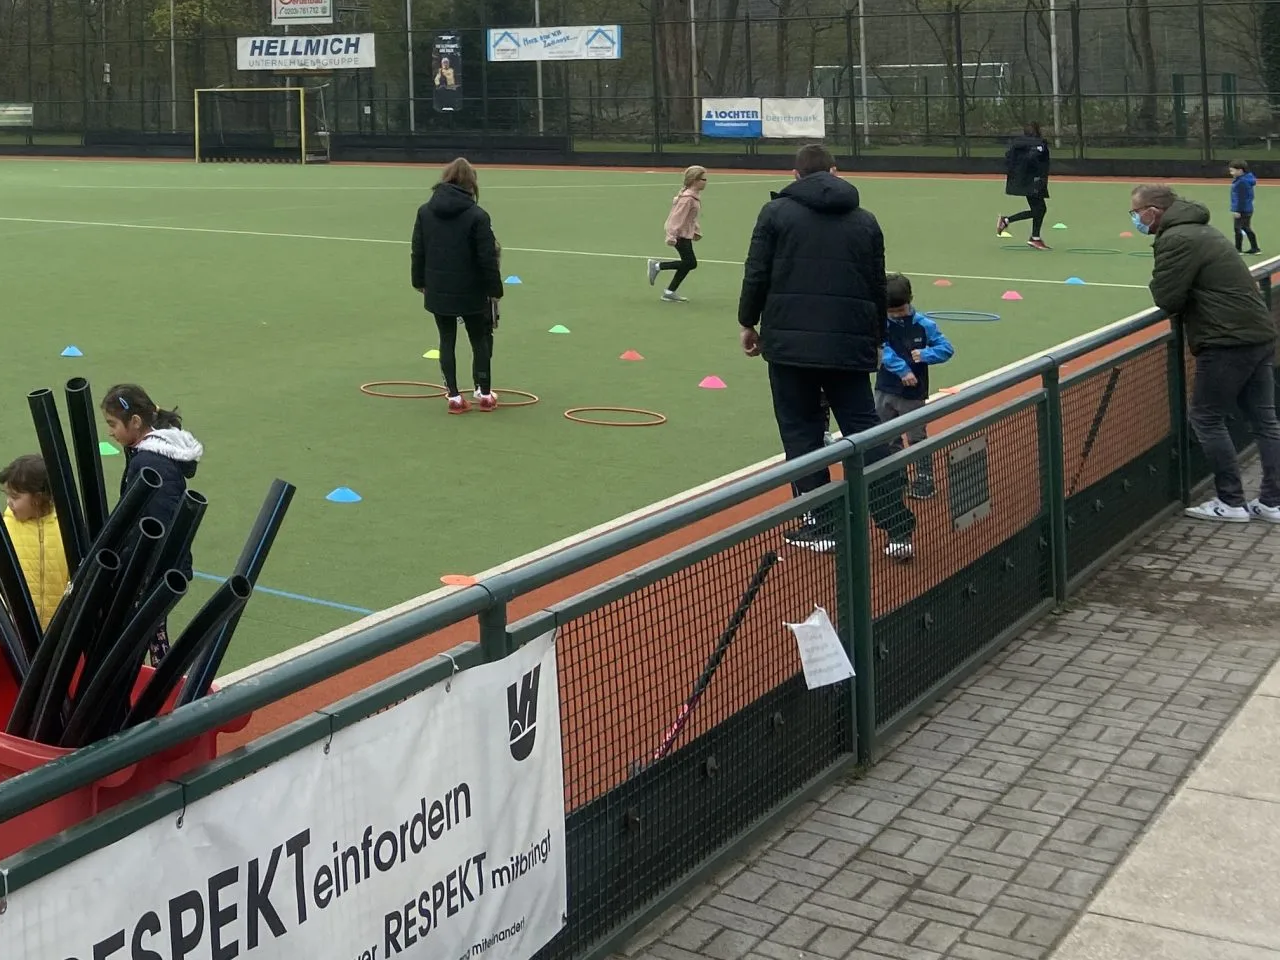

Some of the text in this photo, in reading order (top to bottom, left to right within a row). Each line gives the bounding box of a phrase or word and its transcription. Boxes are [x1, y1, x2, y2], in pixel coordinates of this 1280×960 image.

[249, 37, 360, 56] HELLMICH
[63, 782, 471, 960] SPEKT einfordern
[384, 829, 551, 959] RESPEKT mitbringt
